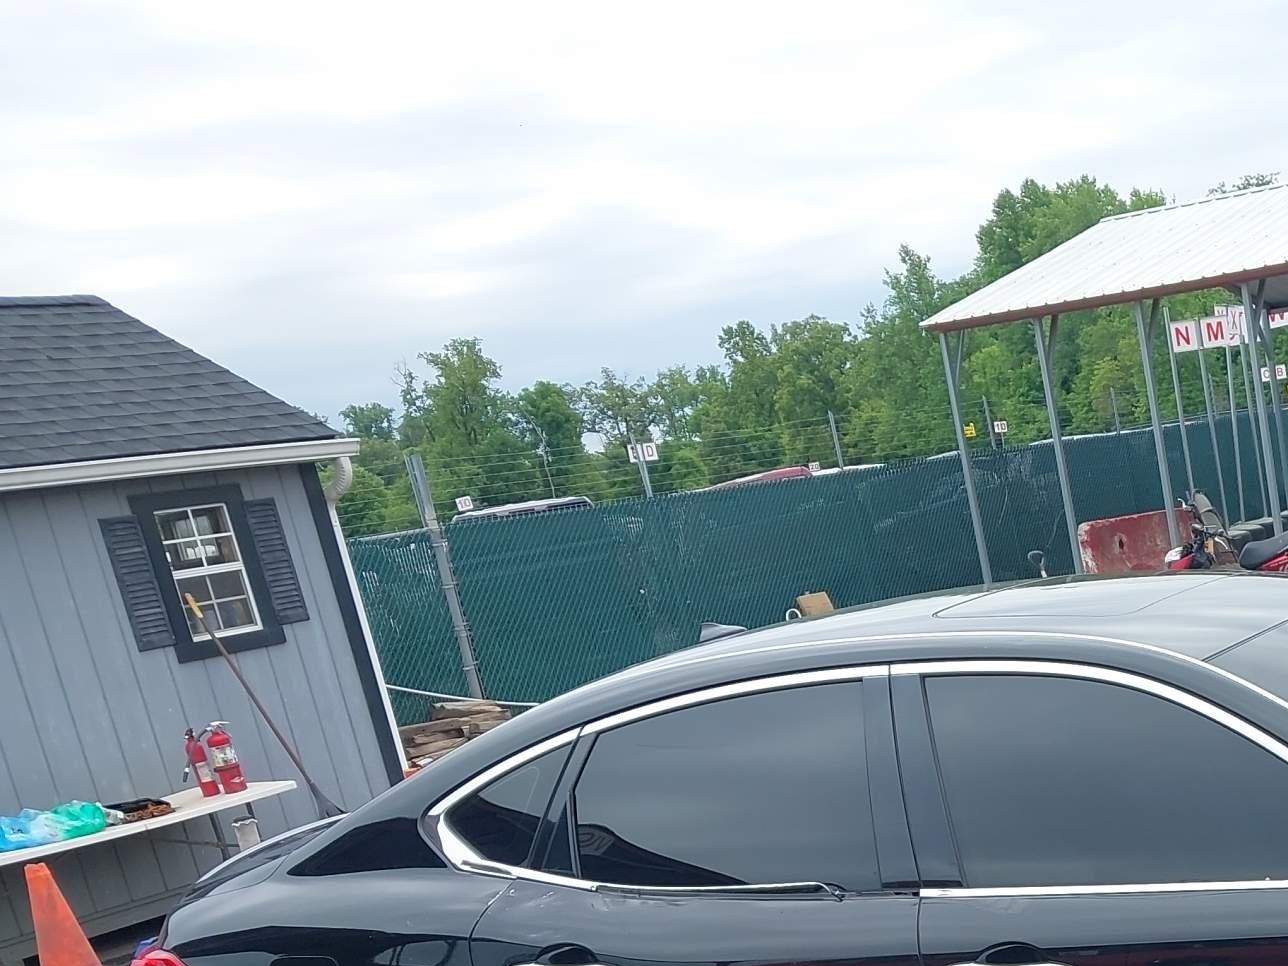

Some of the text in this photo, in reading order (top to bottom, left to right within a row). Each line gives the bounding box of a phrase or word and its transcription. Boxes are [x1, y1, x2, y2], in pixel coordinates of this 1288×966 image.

[1174, 325, 1191, 347] N
[1206, 320, 1225, 342] M
[1277, 367, 1284, 377] B
[646, 445, 654, 457] D
